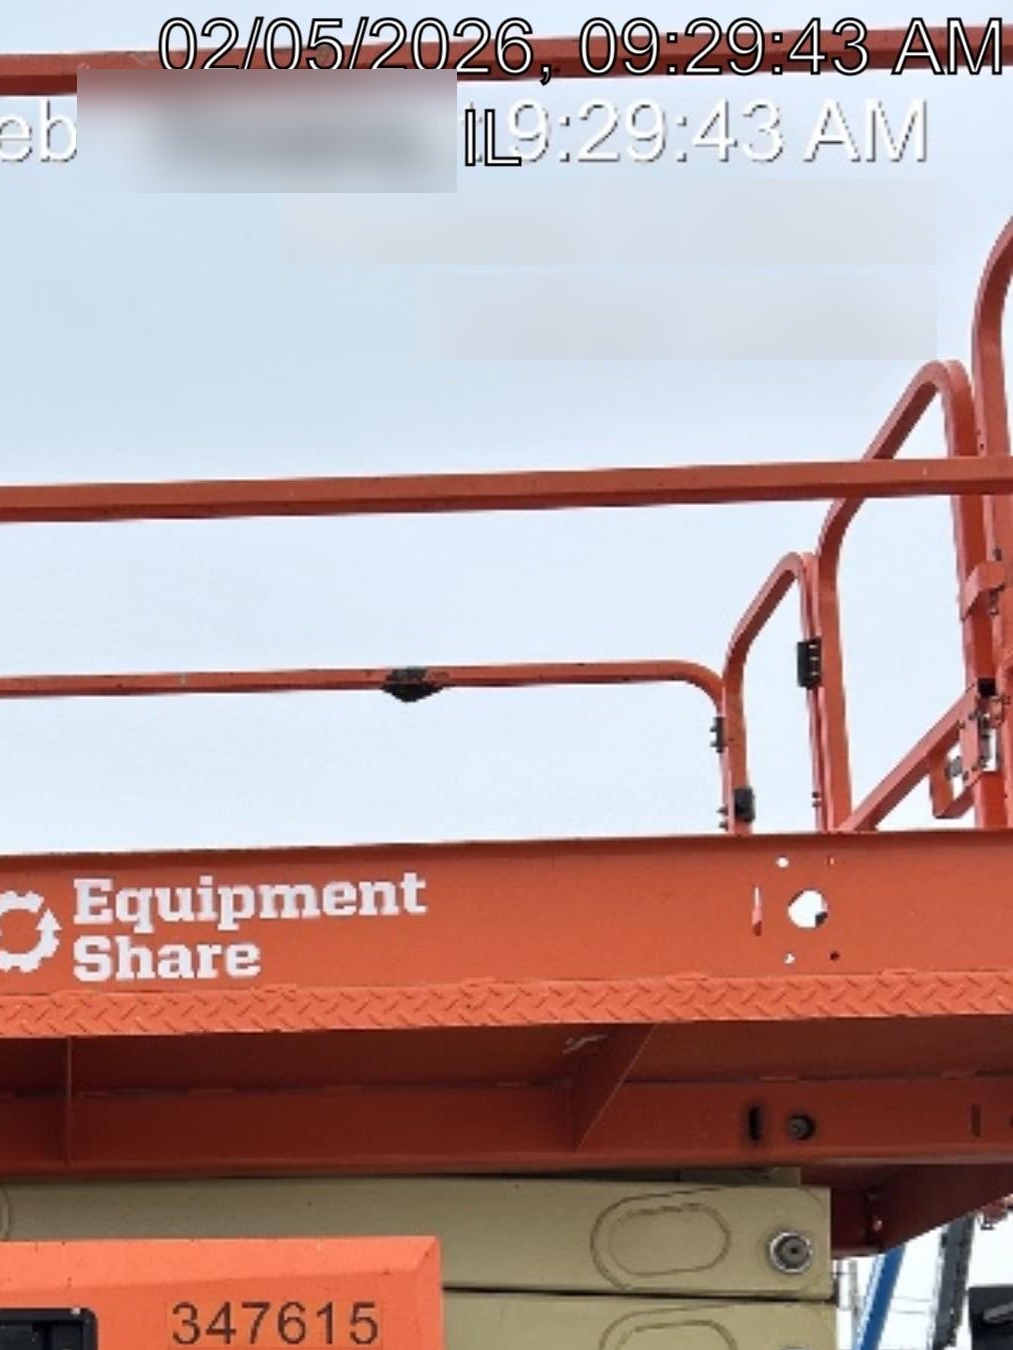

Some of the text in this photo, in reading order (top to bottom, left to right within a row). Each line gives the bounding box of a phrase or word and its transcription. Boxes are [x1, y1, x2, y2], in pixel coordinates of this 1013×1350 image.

[73, 872, 428, 933] Equipment
[73, 935, 261, 982] Share
[171, 1301, 379, 1345] 347615
